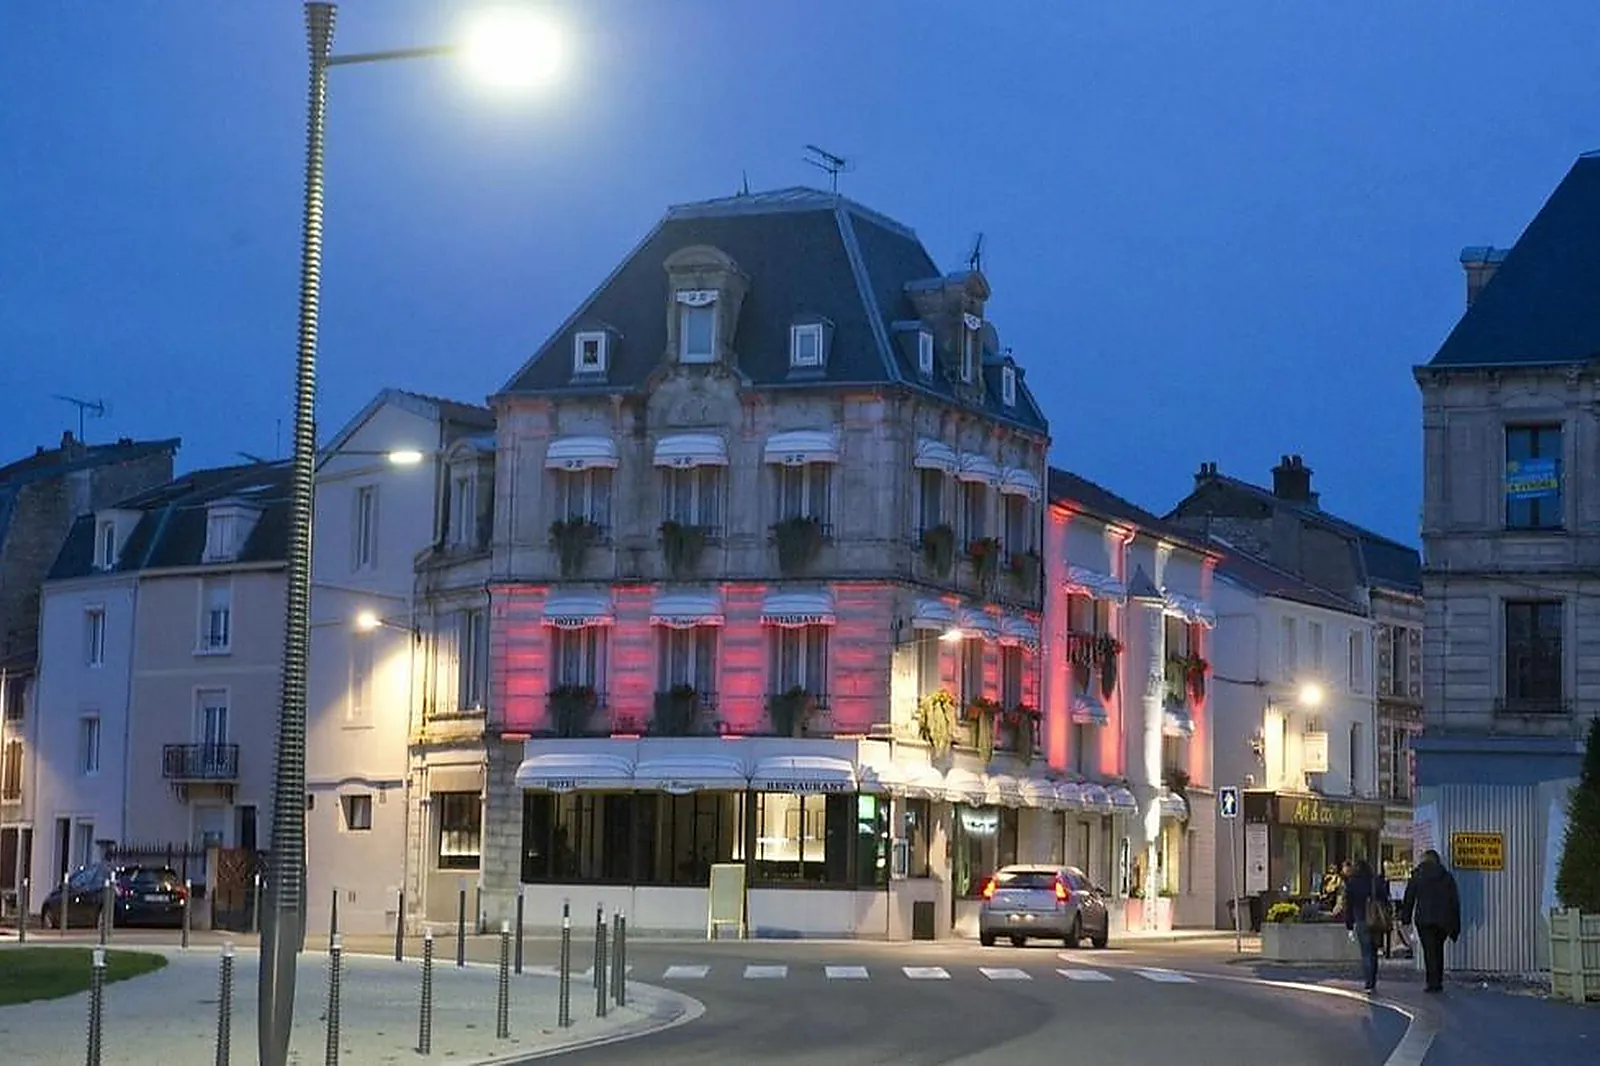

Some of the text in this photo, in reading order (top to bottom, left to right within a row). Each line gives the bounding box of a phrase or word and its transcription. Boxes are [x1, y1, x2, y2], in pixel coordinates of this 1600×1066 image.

[762, 615, 822, 625] RESTAURANT
[767, 780, 846, 791] RESTAURANT
[1456, 836, 1502, 845] ATTENTION
